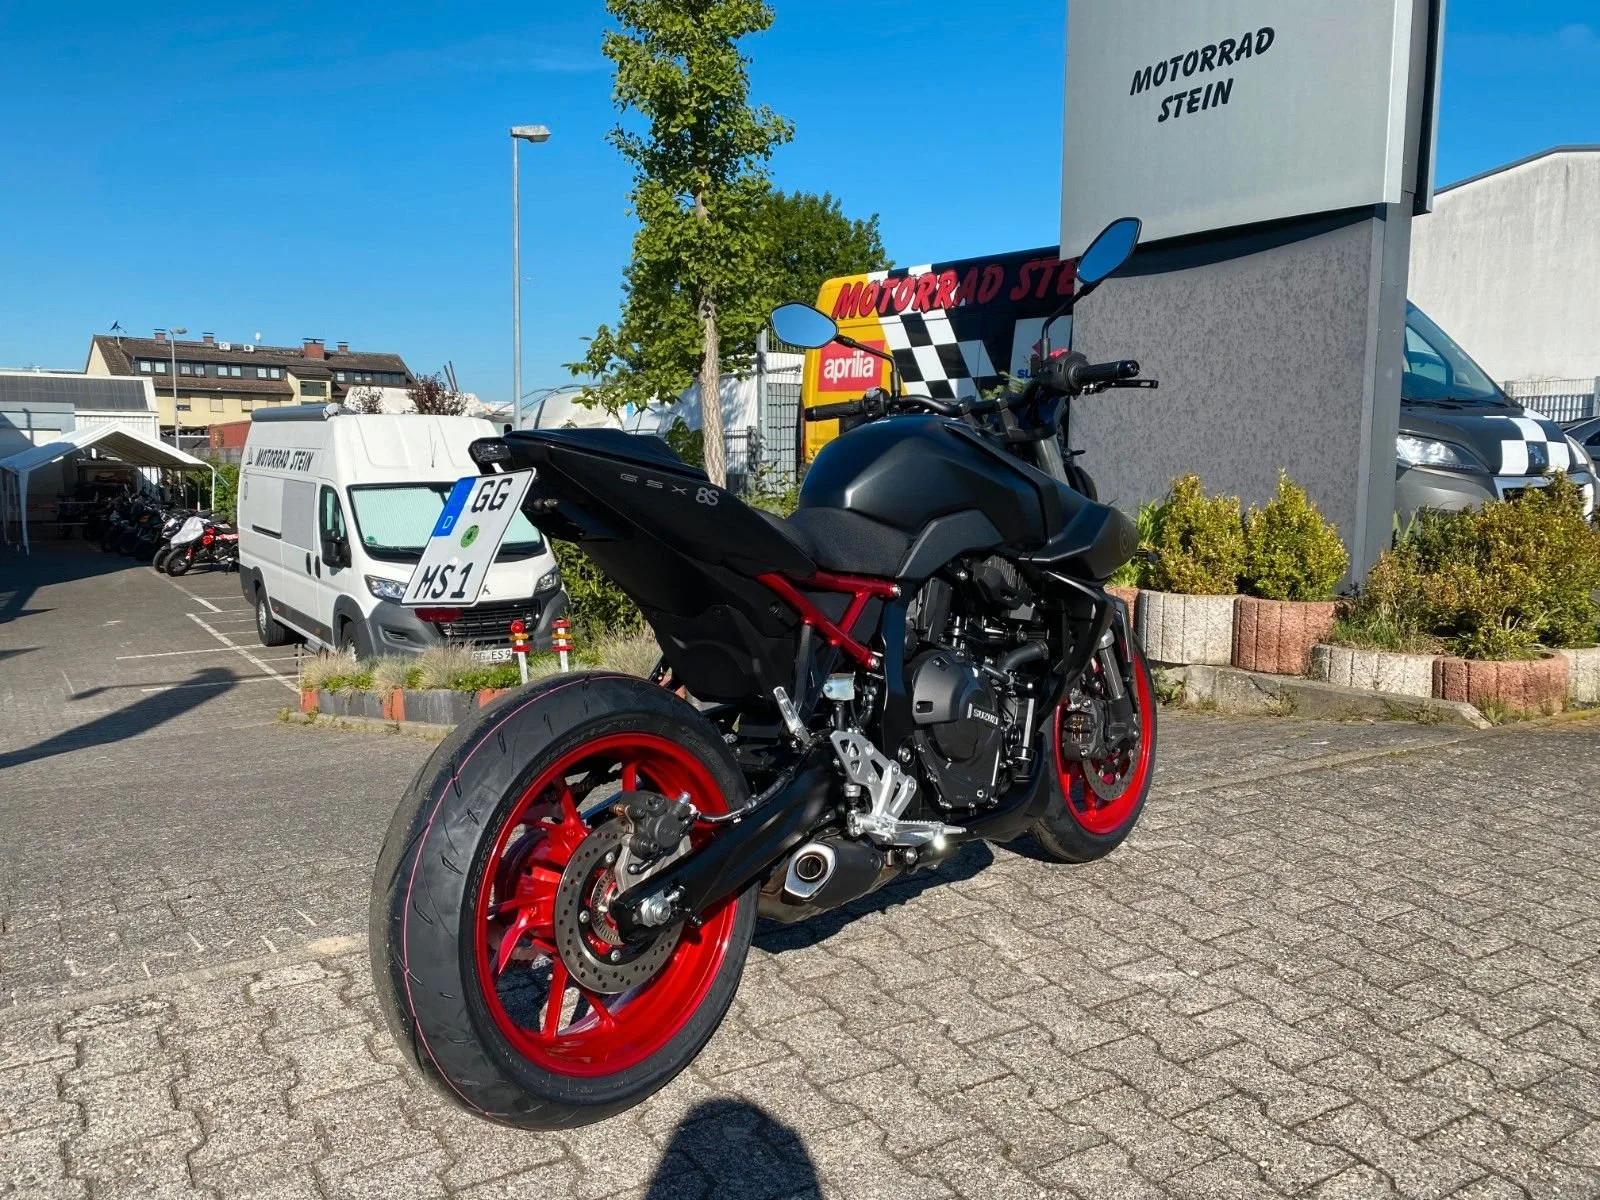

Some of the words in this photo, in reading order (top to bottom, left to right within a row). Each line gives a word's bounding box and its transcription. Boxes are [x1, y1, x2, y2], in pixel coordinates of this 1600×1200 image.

[1130, 26, 1276, 96] MOTORRAD
[1157, 78, 1235, 123] STEIN
[832, 263, 1005, 321] MOTORRAD
[823, 349, 876, 385] aprilia
[254, 447, 291, 470] MOTORRAD
[289, 450, 315, 473] STEIN
[470, 477, 514, 514] GG
[441, 515, 454, 530] D
[973, 708, 999, 726] SUZUKI
